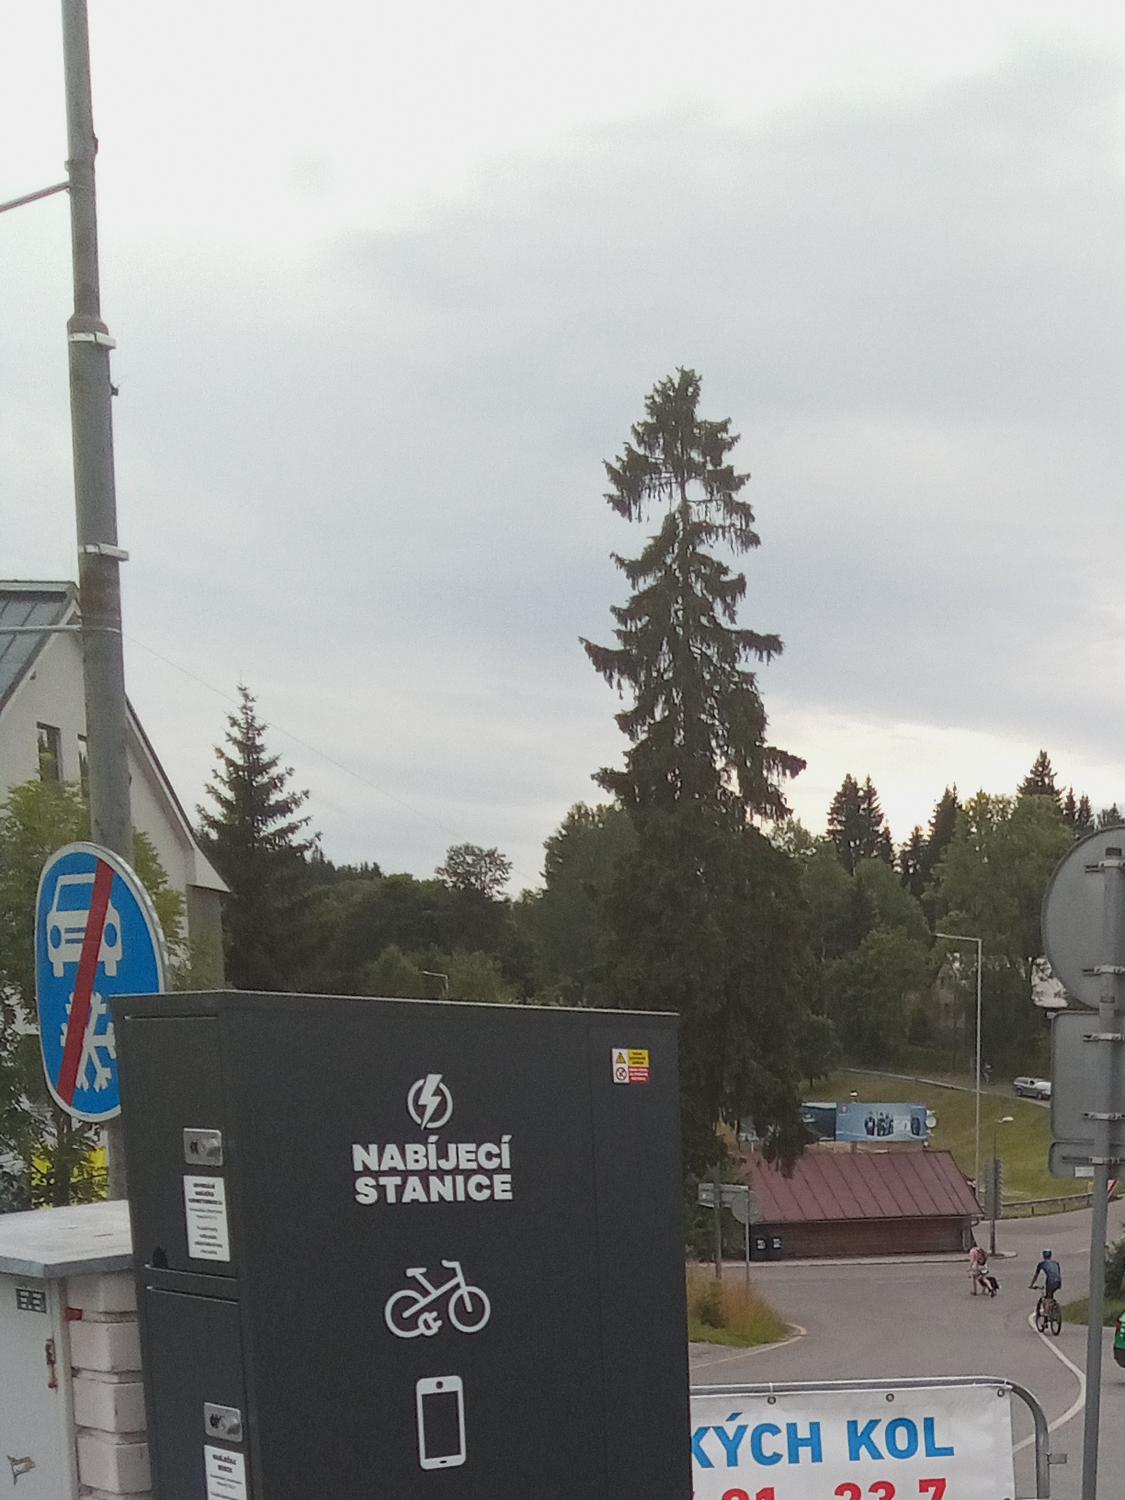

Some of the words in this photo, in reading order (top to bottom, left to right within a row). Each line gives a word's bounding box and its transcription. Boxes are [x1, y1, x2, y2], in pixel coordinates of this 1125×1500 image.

[352, 1135, 512, 1171] NABÍJECÍ
[355, 1174, 513, 1205] STANICE
[847, 1416, 954, 1461] KOL
